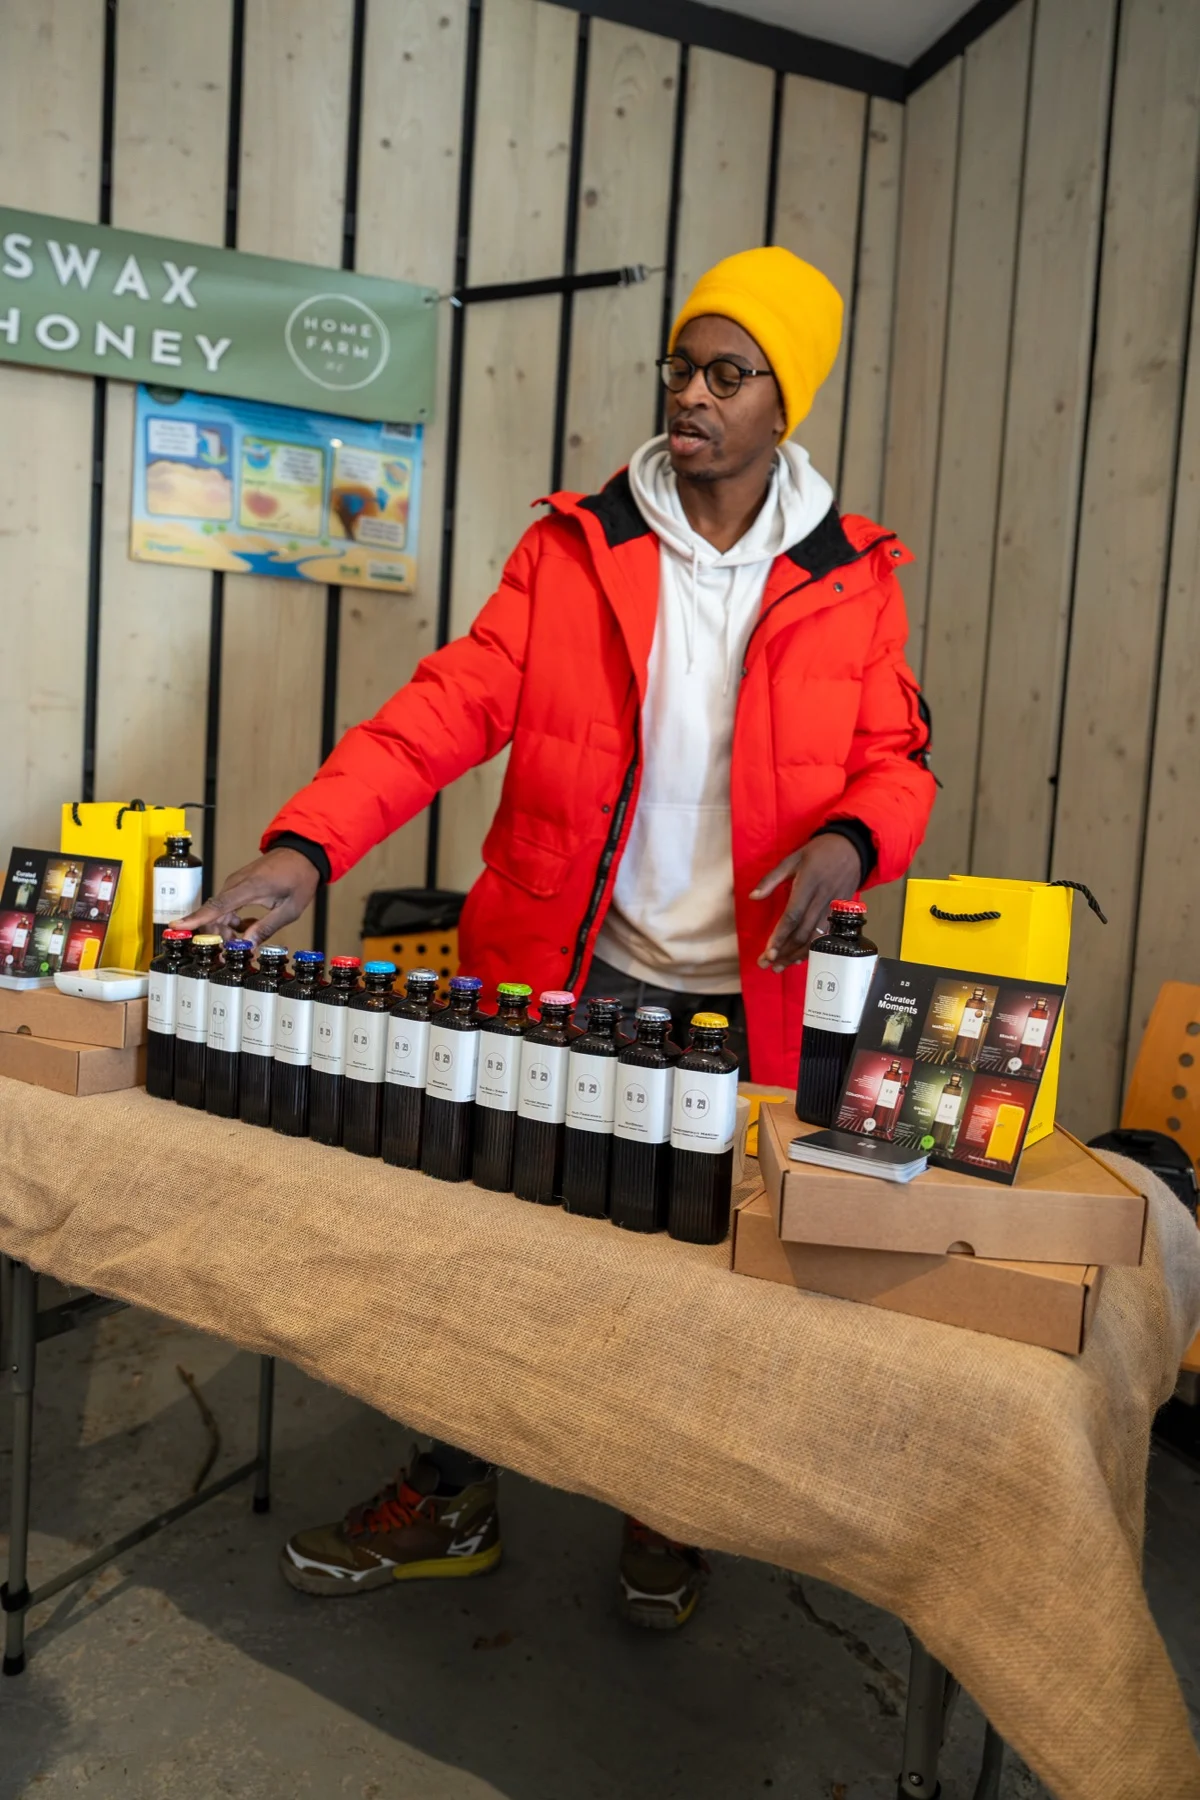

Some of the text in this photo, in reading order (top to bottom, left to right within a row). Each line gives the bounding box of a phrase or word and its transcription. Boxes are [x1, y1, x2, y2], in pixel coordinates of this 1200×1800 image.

[2, 232, 199, 308] SWAX
[303, 315, 373, 339] HOME
[305, 335, 370, 360] FARM
[877, 999, 918, 1015] Moments
[884, 993, 916, 1005] Curated
[685, 1097, 706, 1110] 19 29
